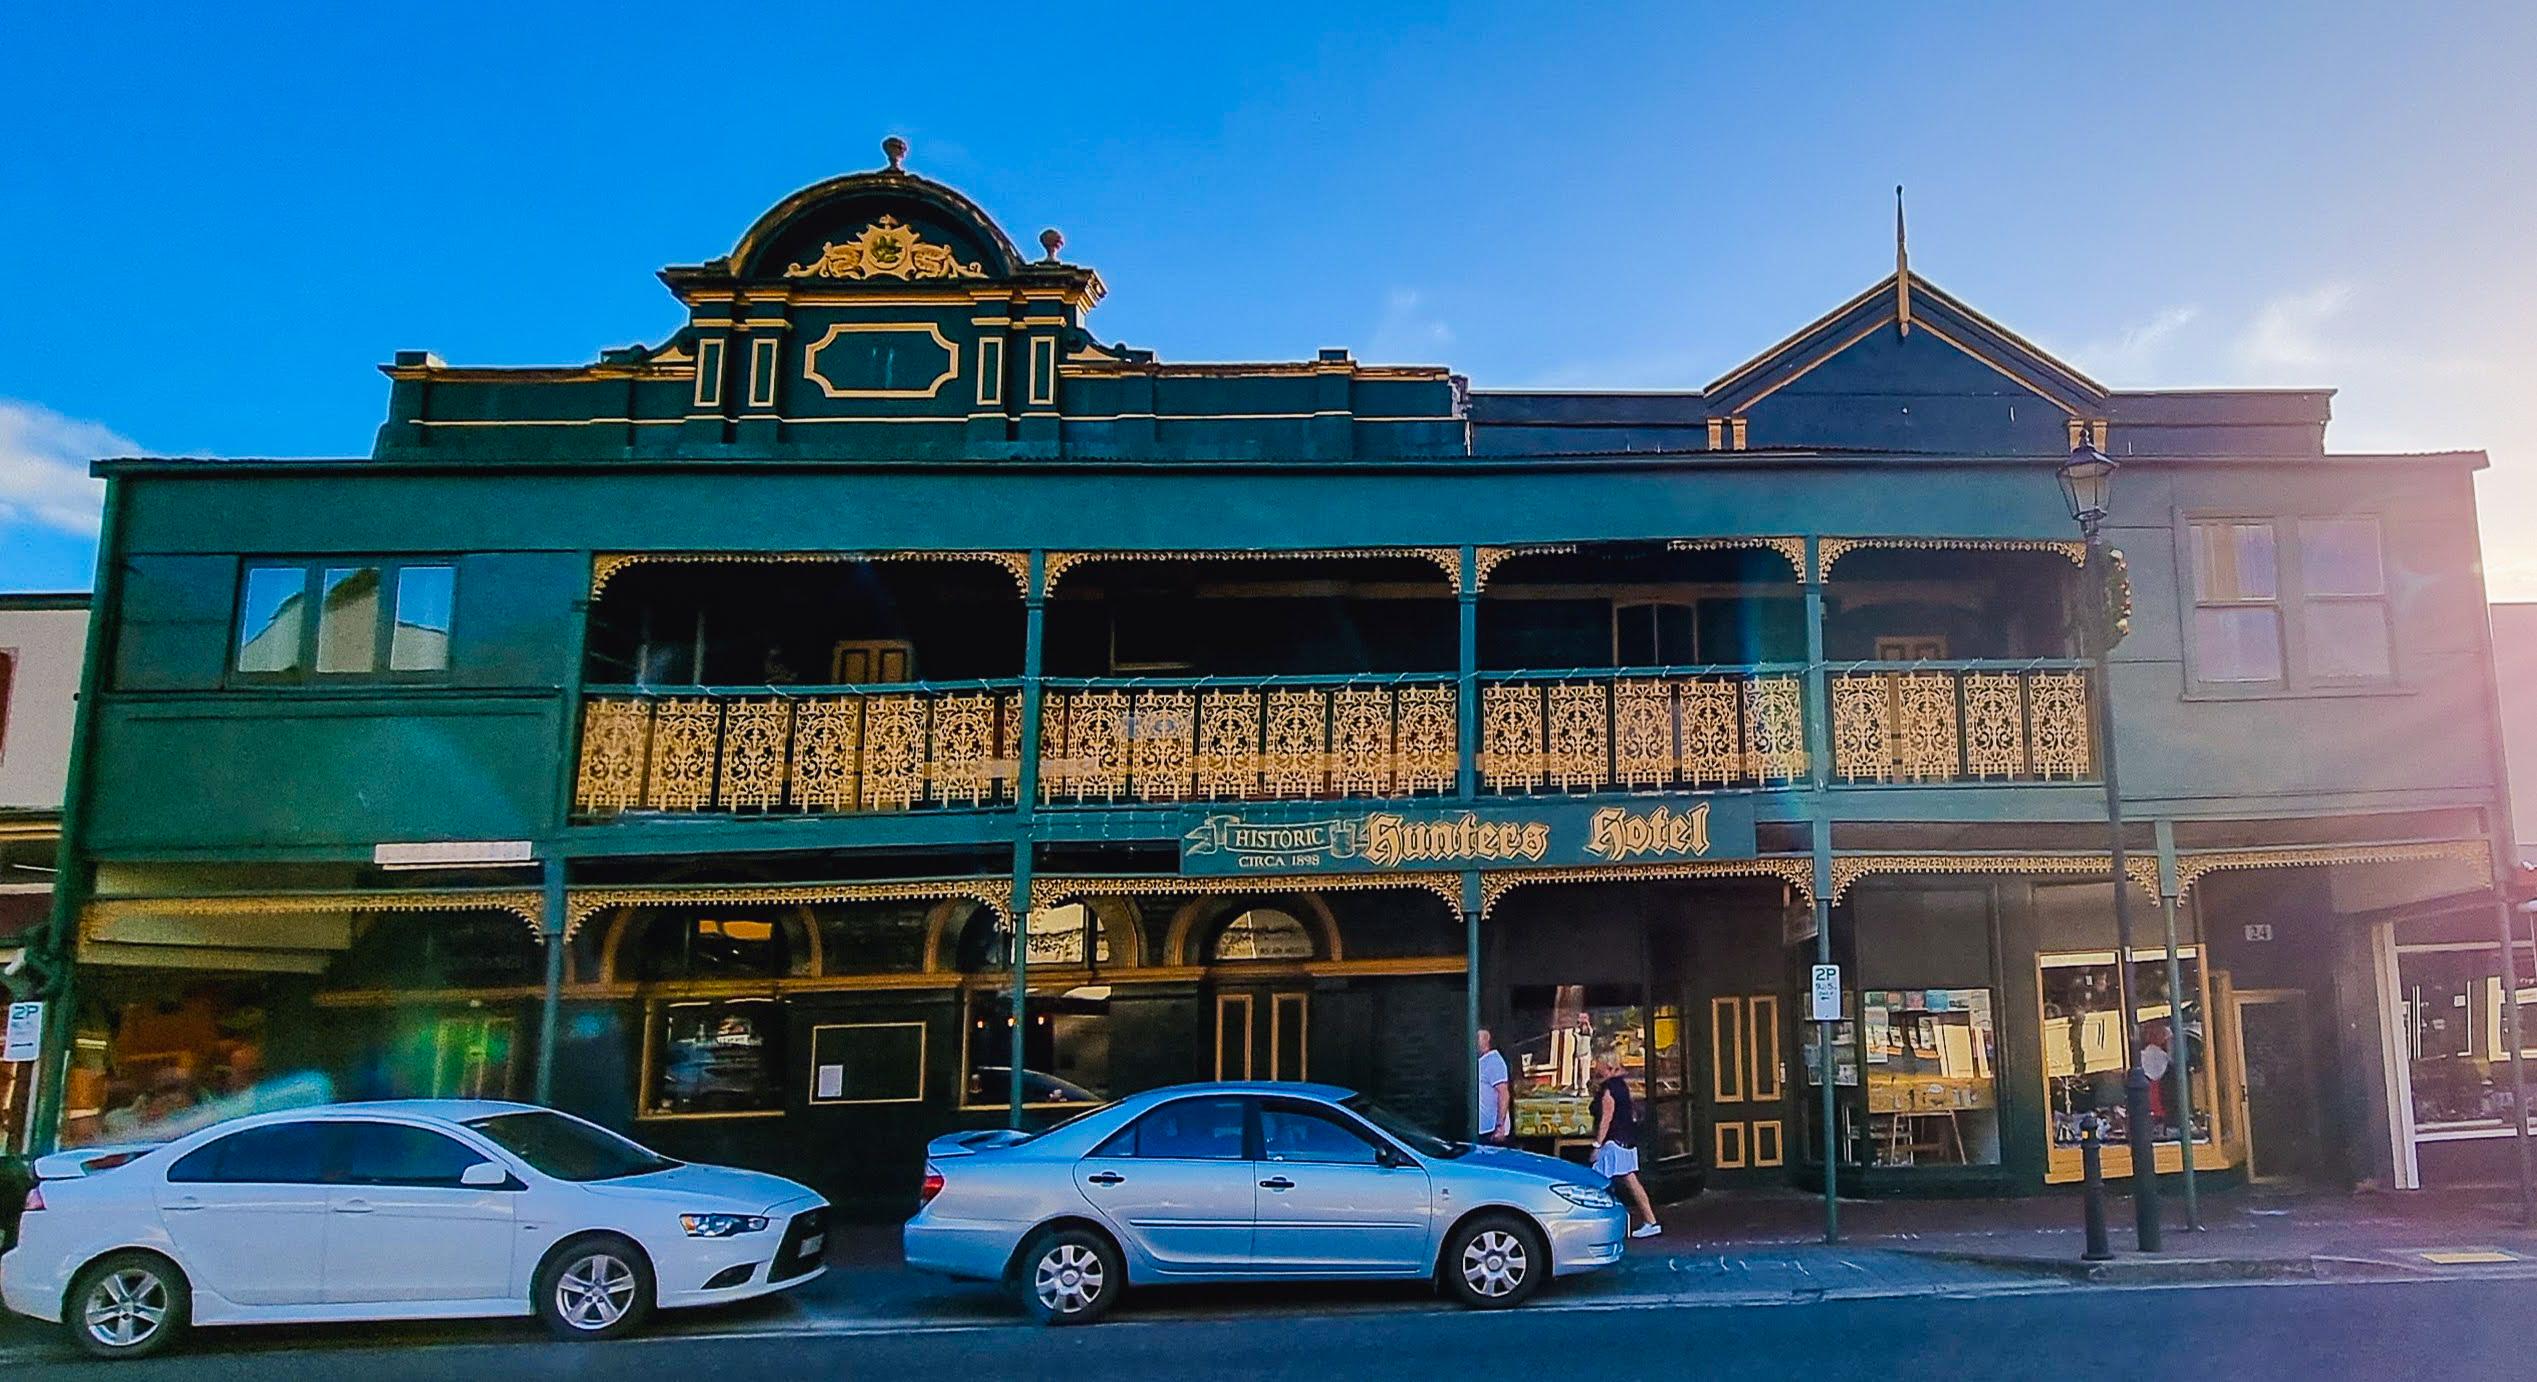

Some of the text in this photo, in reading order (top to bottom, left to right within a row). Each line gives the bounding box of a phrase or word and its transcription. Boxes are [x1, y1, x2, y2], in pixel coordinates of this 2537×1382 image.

[1235, 827, 1325, 849] HISTORIC
[1361, 801, 1711, 868] Hunters Hotel
[1238, 855, 1320, 868] CIRCA 1898
[1815, 968, 1837, 981] 2P
[12, 1004, 39, 1019] 2P
